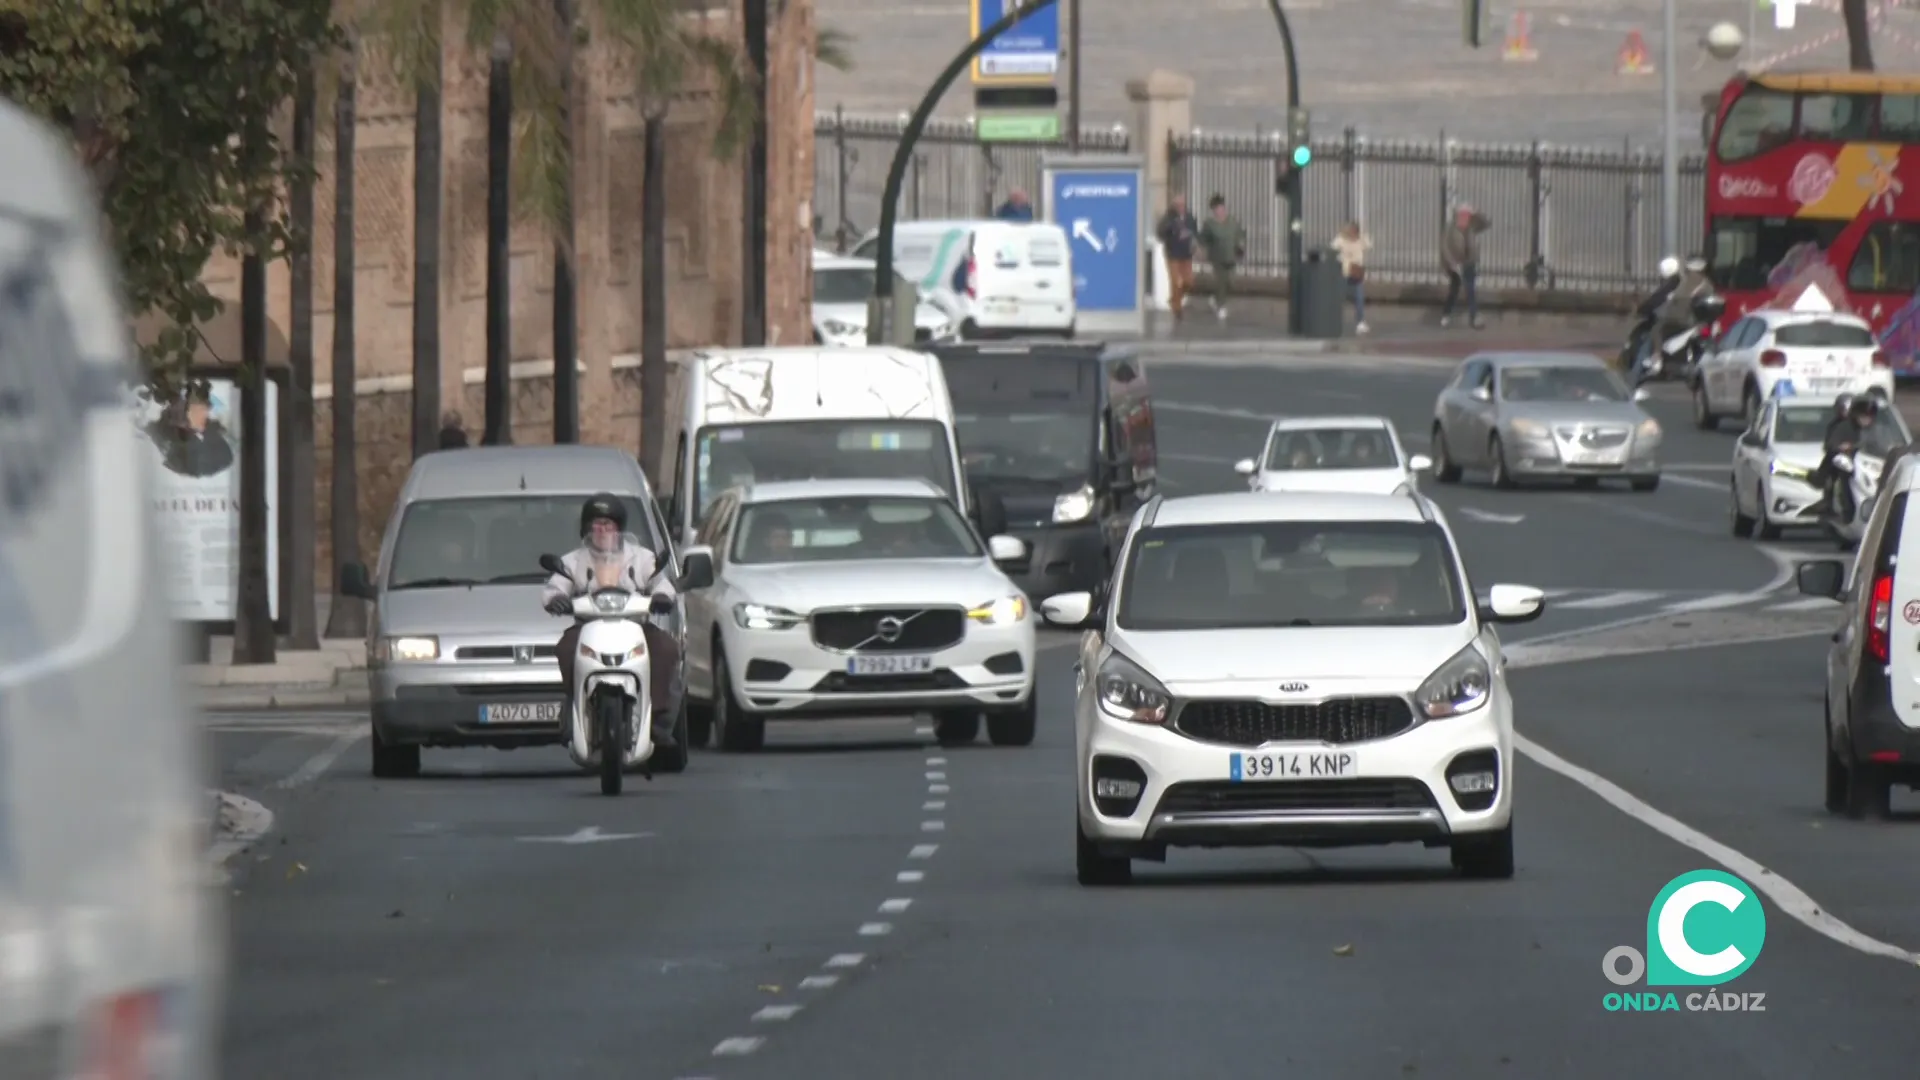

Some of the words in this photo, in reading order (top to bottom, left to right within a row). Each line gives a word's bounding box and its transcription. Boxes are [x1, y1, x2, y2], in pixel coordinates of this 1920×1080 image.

[1279, 682, 1310, 693] KIA
[491, 704, 530, 720] 4070
[1247, 755, 1301, 777] 3914
[1310, 754, 1351, 776] KNP
